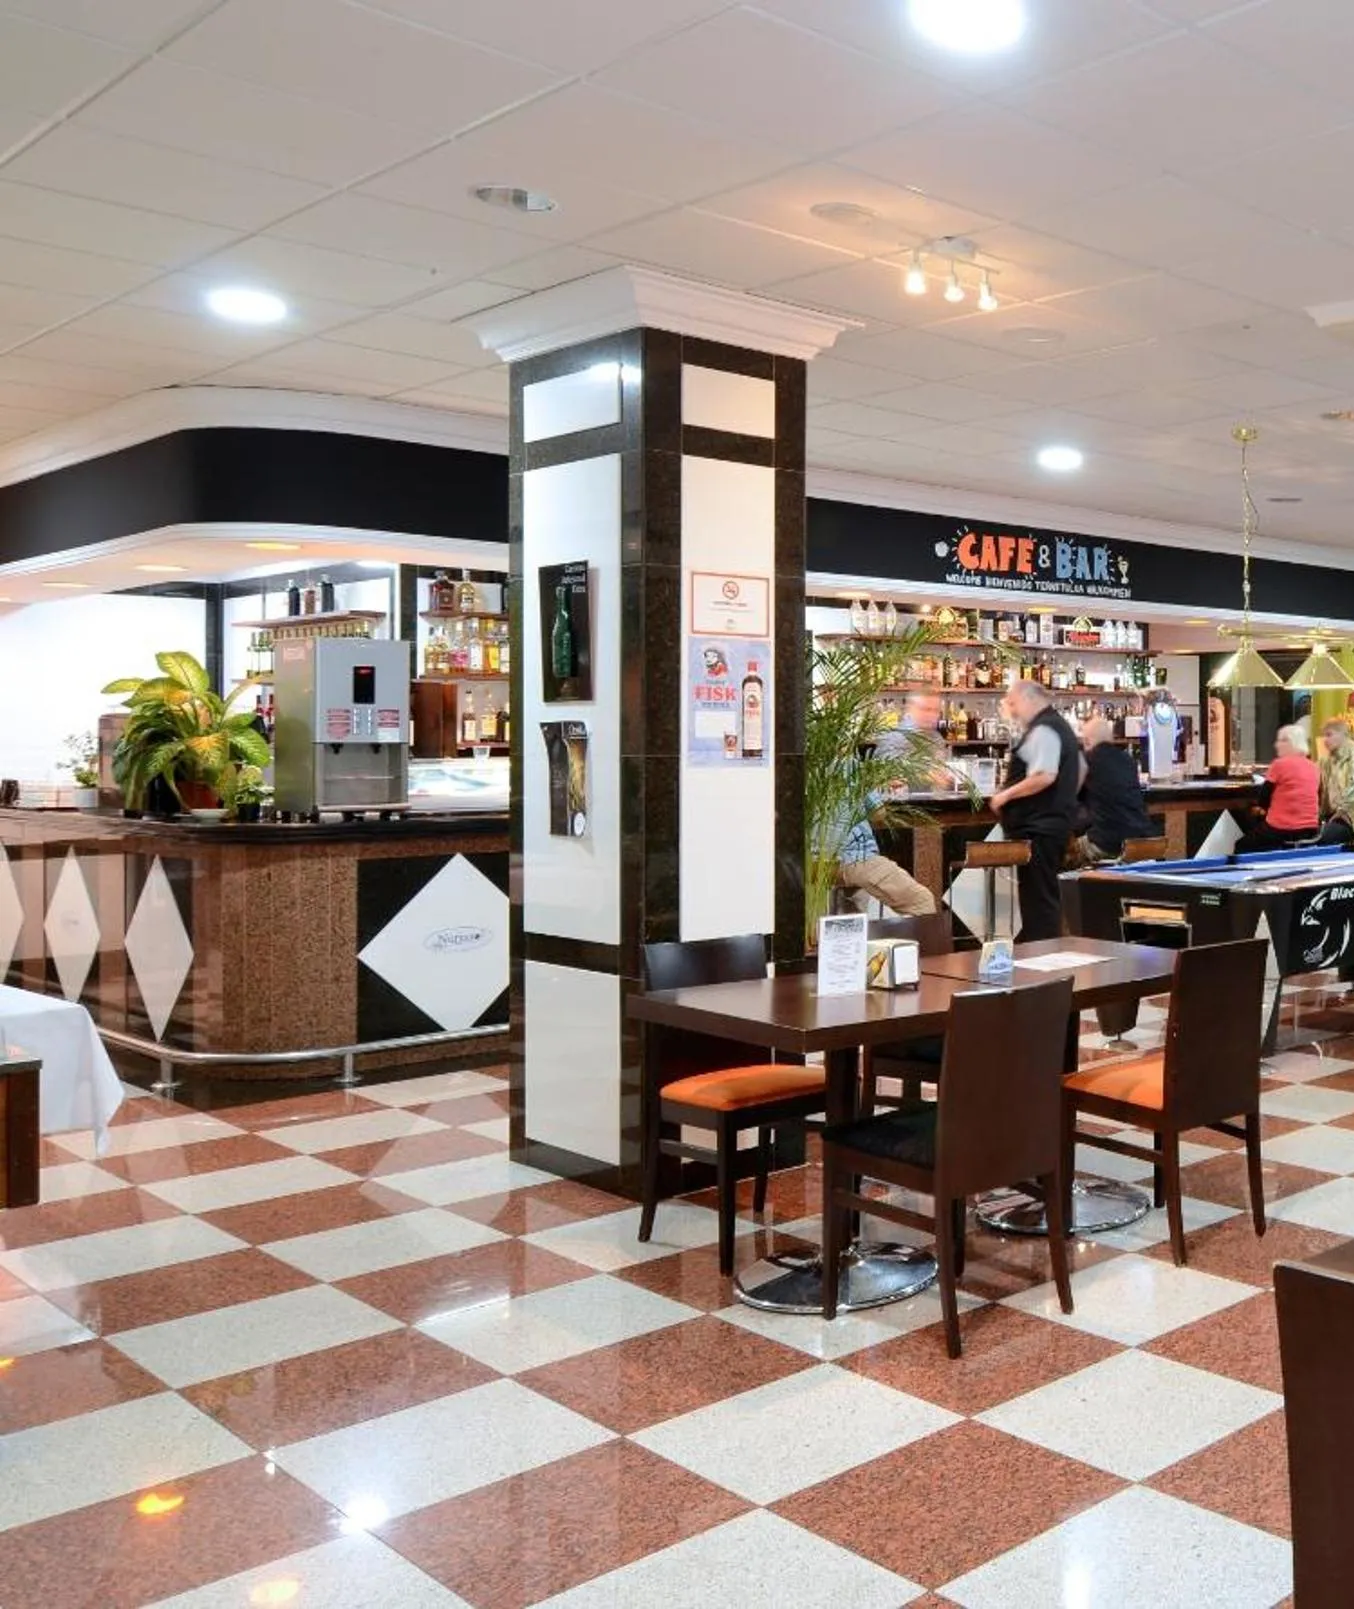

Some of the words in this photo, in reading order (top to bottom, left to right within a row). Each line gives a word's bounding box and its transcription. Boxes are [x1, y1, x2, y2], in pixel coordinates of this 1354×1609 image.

[957, 532, 1034, 573] CAFE
[1038, 544, 1051, 568] &
[1055, 540, 1110, 581] BAR
[945, 573, 982, 586] WELCOME
[694, 686, 737, 701] FISK
